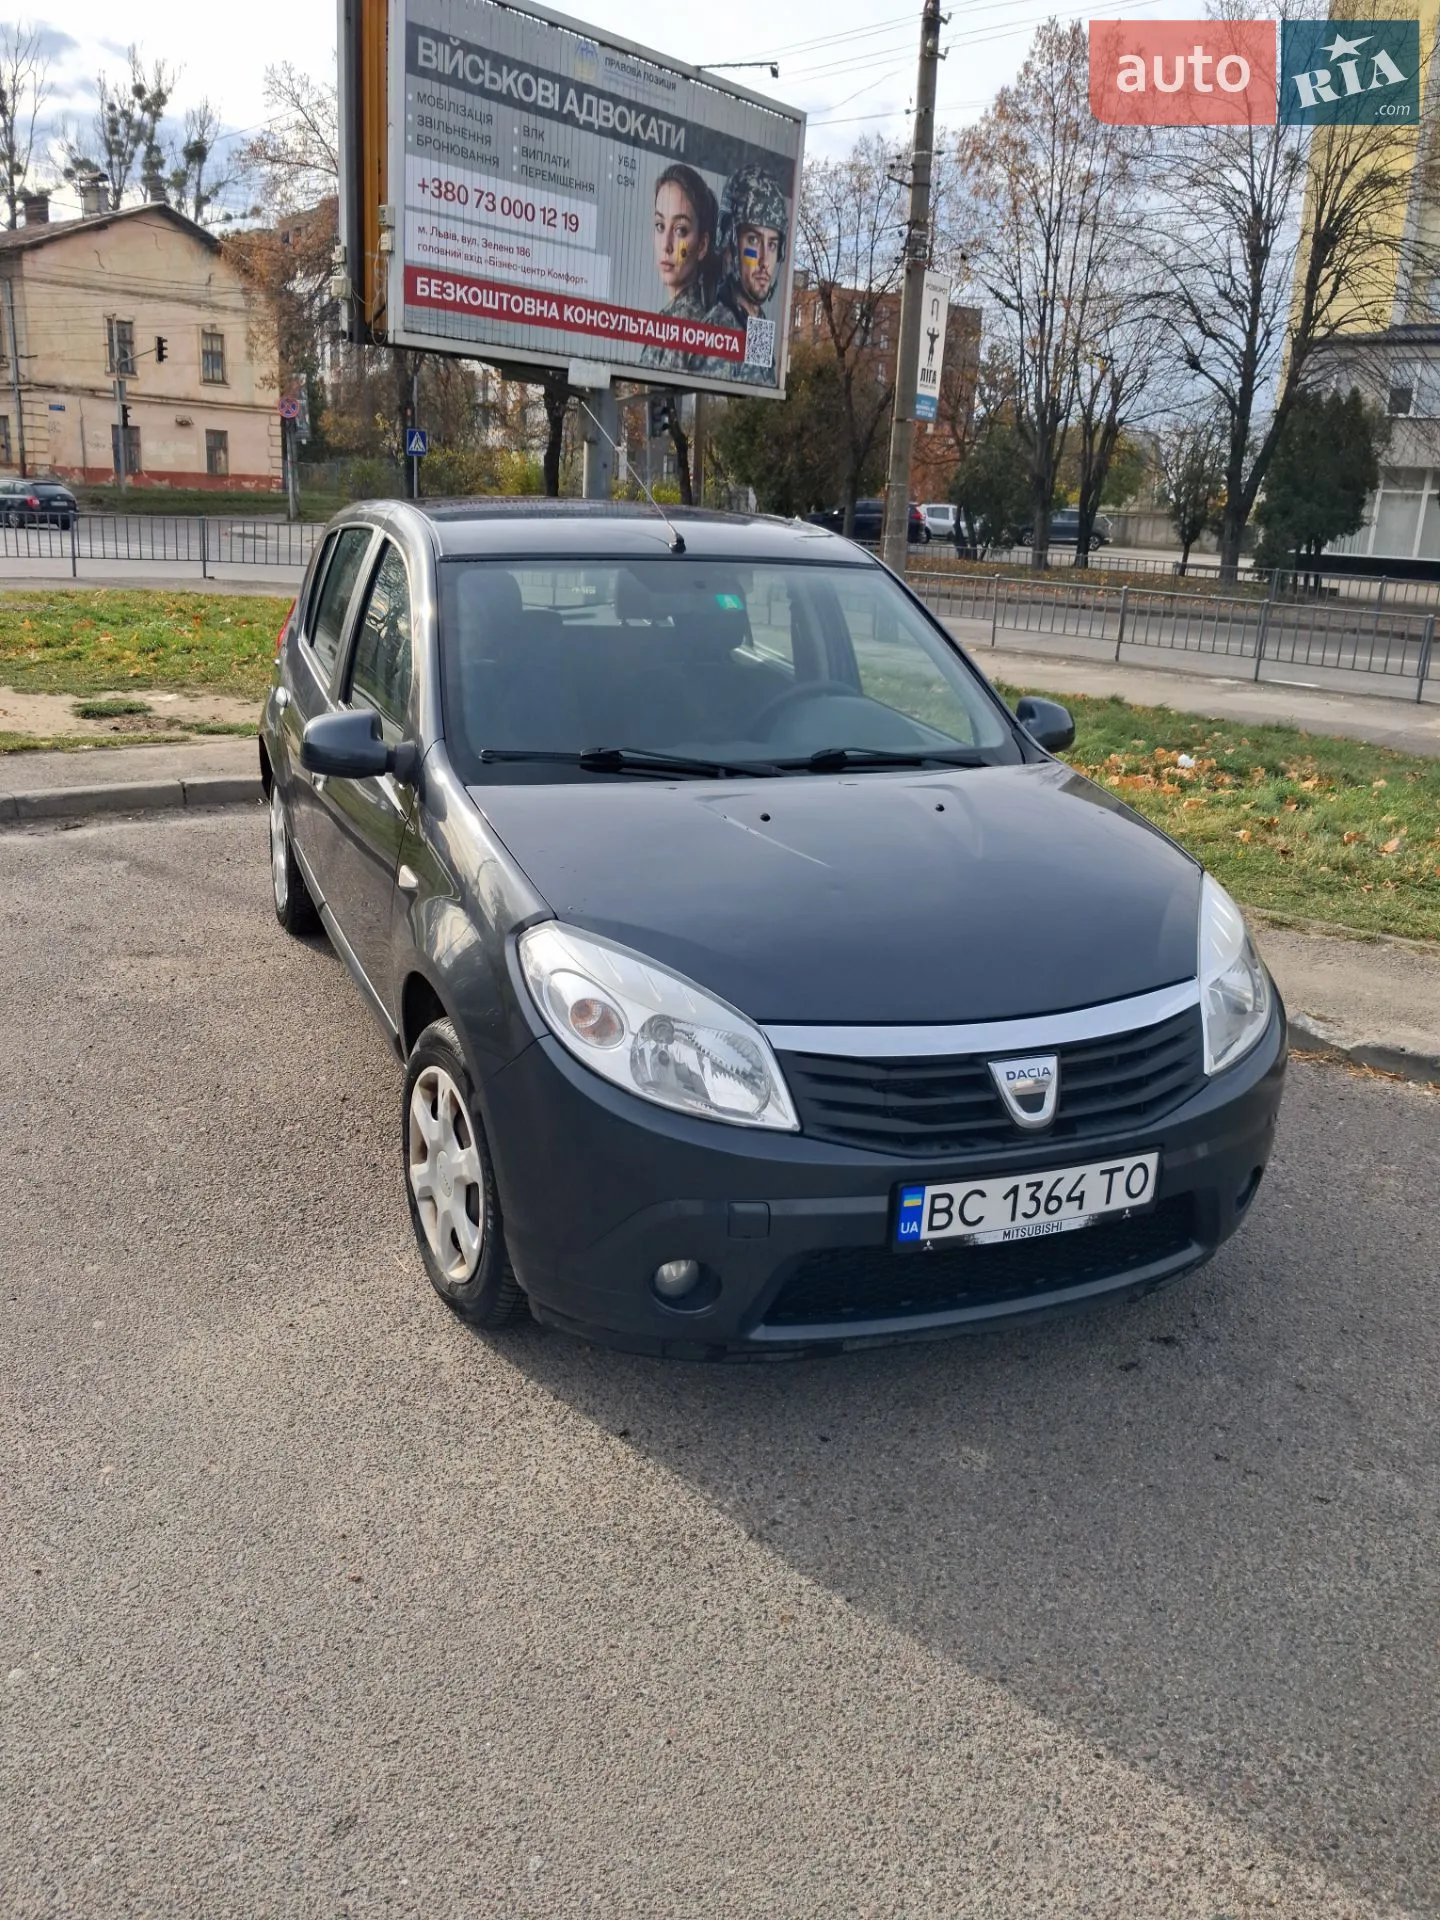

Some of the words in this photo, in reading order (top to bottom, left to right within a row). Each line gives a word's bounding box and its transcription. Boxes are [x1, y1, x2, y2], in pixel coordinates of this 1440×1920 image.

[417, 35, 560, 111] ВІЙСЬКОВІ
[562, 87, 686, 153] АДВОКАТИ
[417, 91, 493, 126] МОБІЛІЗАЦІЯ
[417, 114, 492, 147] ЗВІЛЬНЕННЯ
[522, 125, 545, 142] ВЛК
[416, 134, 500, 168] БРОНЮВАННЯ
[521, 146, 570, 168] ВИПЛАТИ
[617, 154, 637, 171] УБД
[417, 177, 469, 206] +380
[473, 188, 497, 212] 73
[501, 196, 536, 222] 000
[540, 206, 557, 228] 12
[562, 211, 579, 233] 19
[417, 243, 462, 260] головний
[516, 245, 531, 258] 186
[416, 276, 560, 321] БЕЗКОШТОВНА
[563, 304, 680, 342] КОНСУЛЬТАЦІЯ
[682, 325, 740, 353] ЮРИСТА
[1005, 1066, 1051, 1081] DACIA
[927, 1188, 987, 1232] BC
[1002, 1173, 1087, 1222] 1364
[1100, 1162, 1149, 1205] TO
[900, 1221, 919, 1234] UA
[1002, 1221, 1063, 1241] MITSUBISHI
